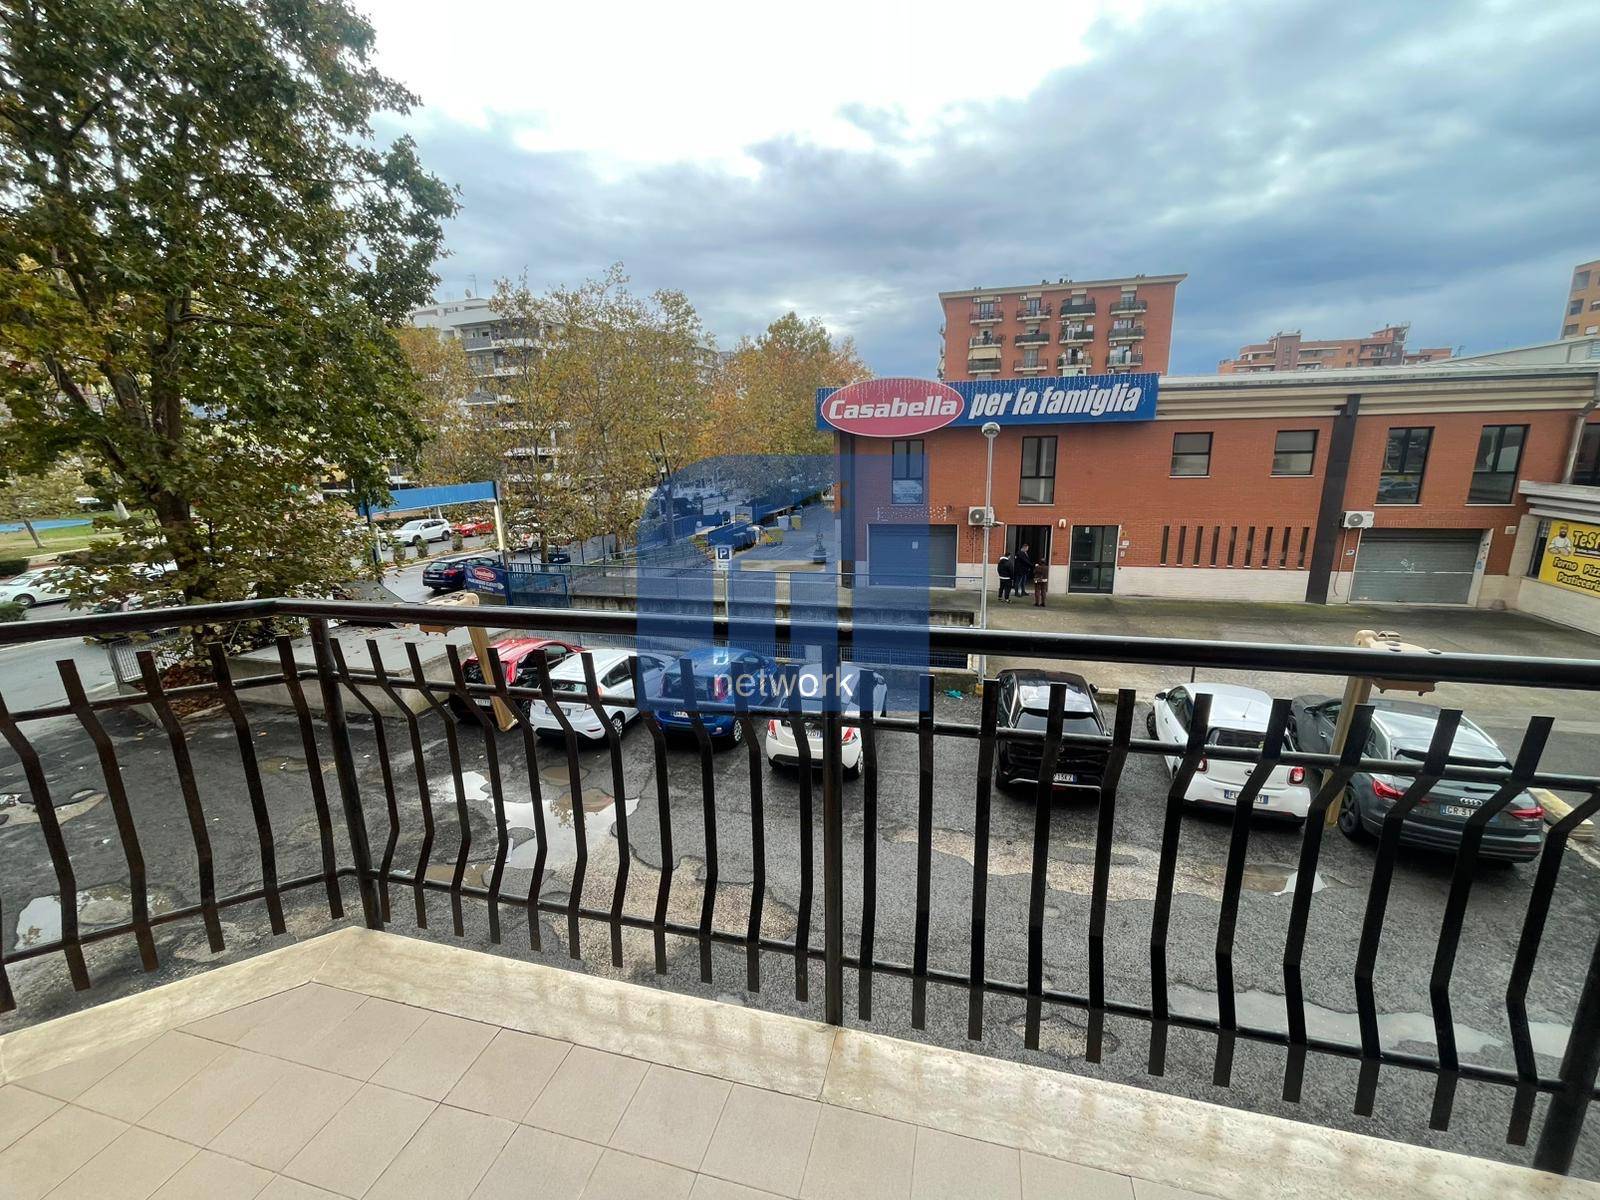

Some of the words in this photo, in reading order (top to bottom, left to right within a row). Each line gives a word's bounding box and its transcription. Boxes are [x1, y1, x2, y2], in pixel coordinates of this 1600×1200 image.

[828, 396, 958, 420] Casabella
[968, 391, 1014, 420] per
[1012, 386, 1040, 416] la
[1039, 383, 1142, 417] famiglia
[719, 548, 728, 559] P
